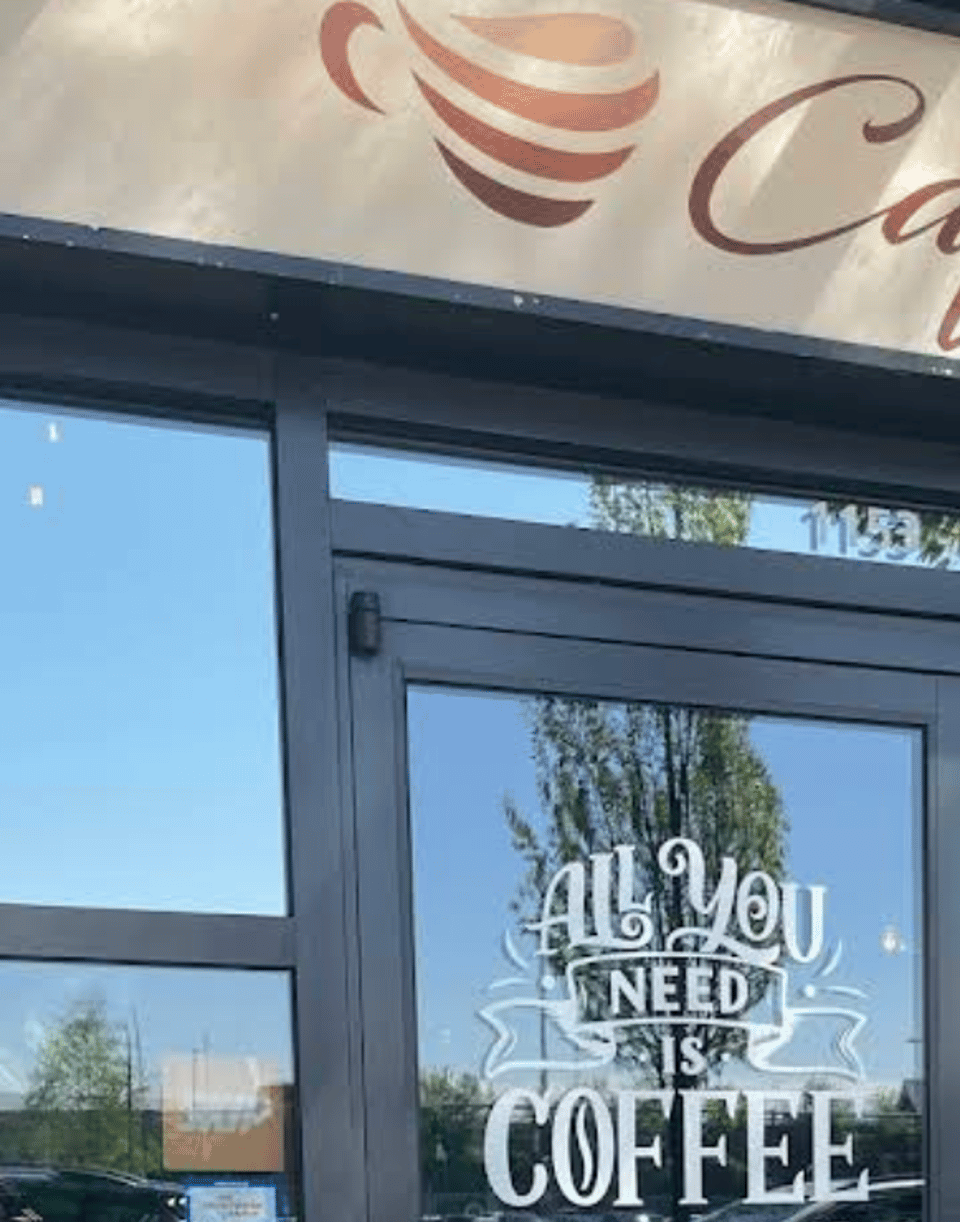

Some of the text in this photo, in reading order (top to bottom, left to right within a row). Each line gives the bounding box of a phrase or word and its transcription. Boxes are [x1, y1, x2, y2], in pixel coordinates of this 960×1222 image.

[525, 844, 654, 957] ALL
[609, 966, 749, 1015] NEED
[661, 1036, 708, 1076] IS
[483, 1088, 872, 1208] COFFEE
